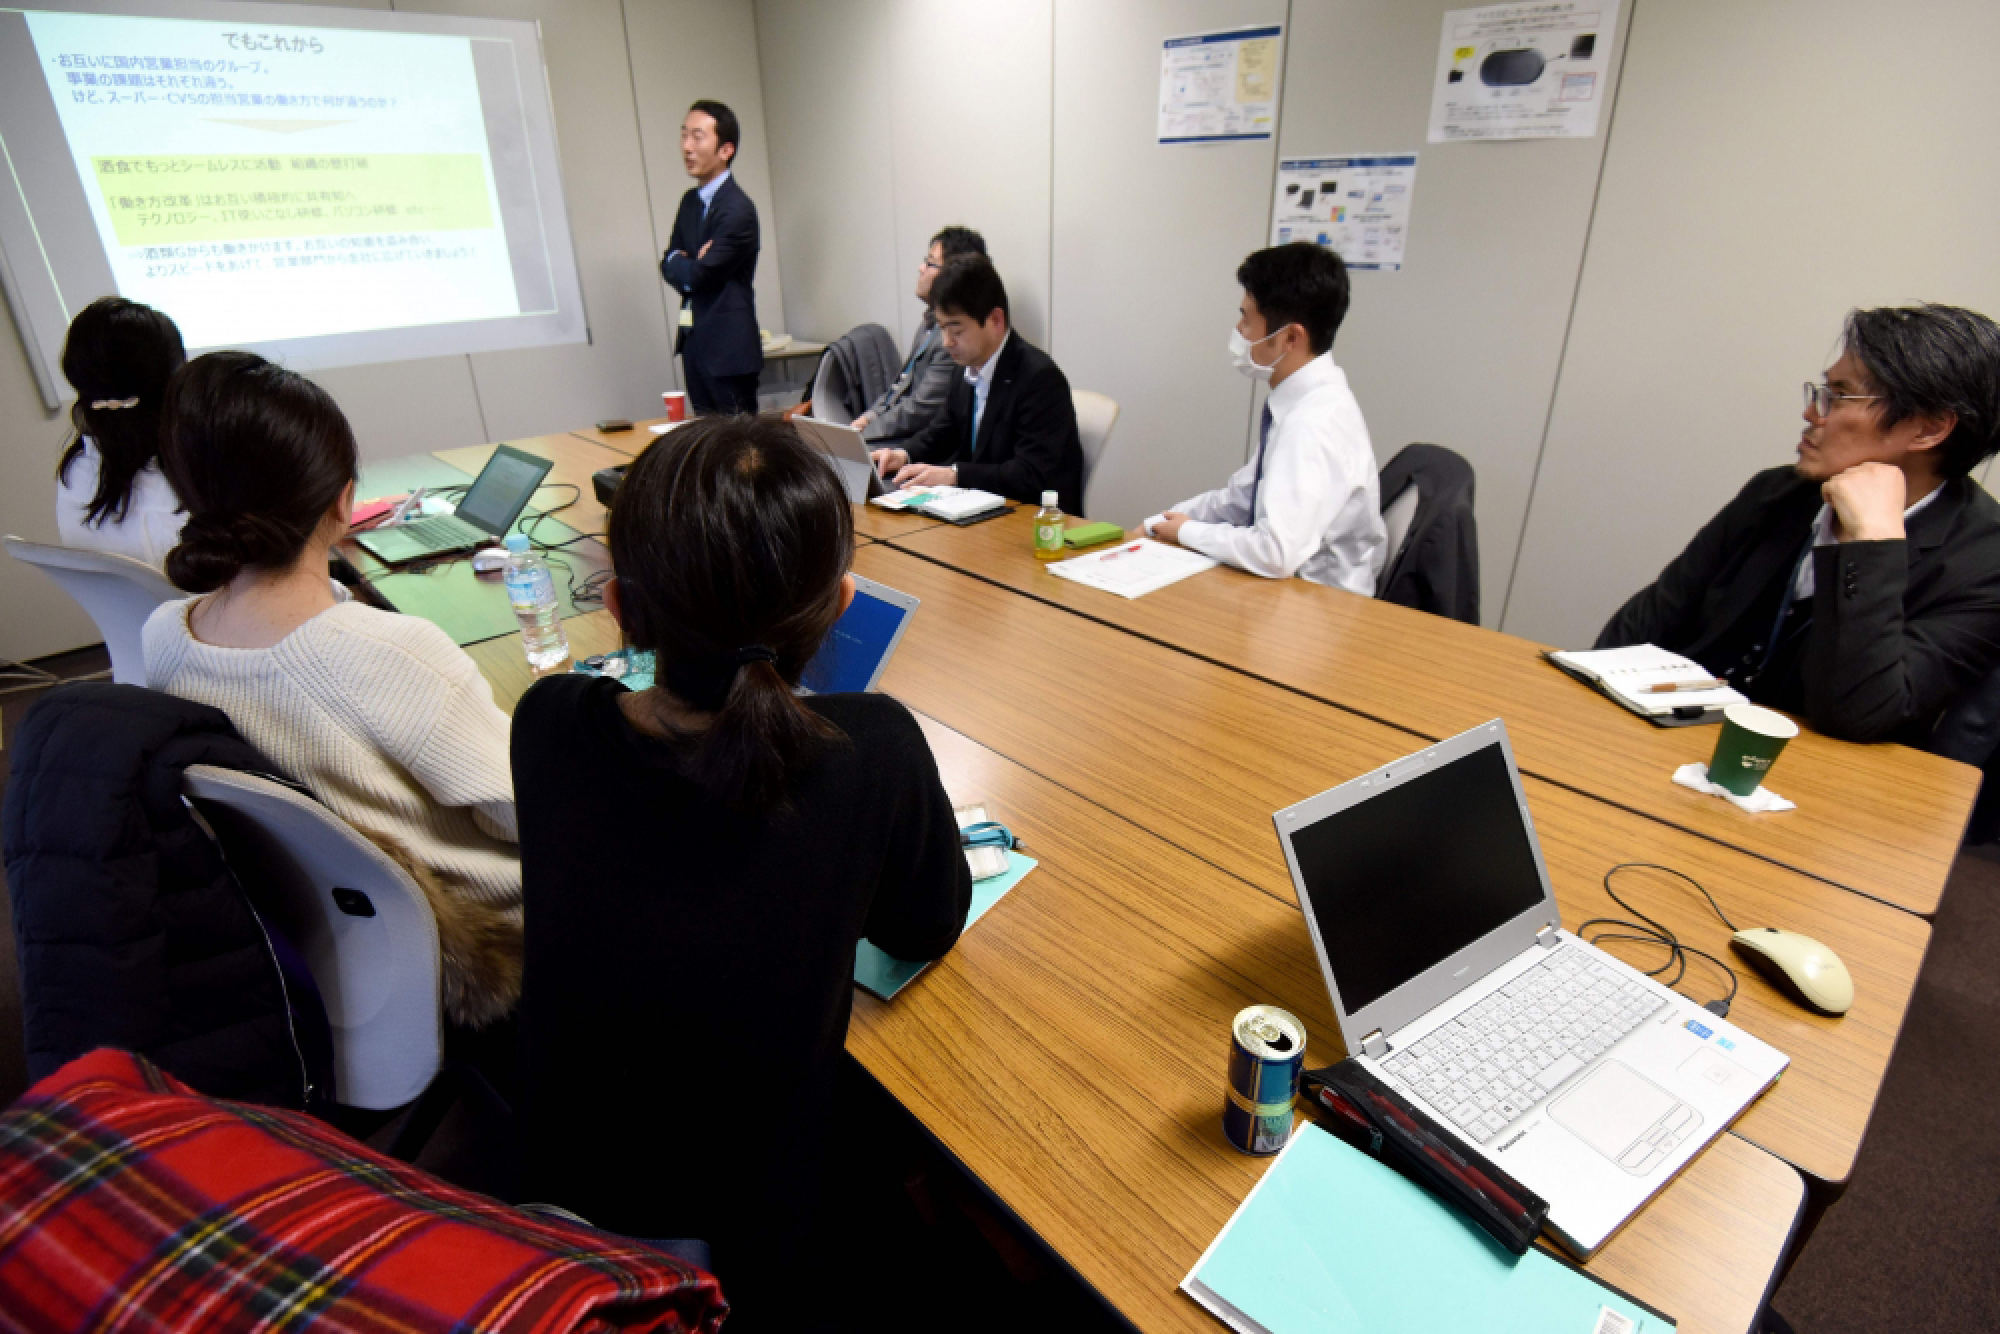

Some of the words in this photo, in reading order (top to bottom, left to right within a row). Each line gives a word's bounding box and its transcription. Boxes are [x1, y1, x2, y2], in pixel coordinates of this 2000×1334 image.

[221, 31, 324, 54] でもこれから
